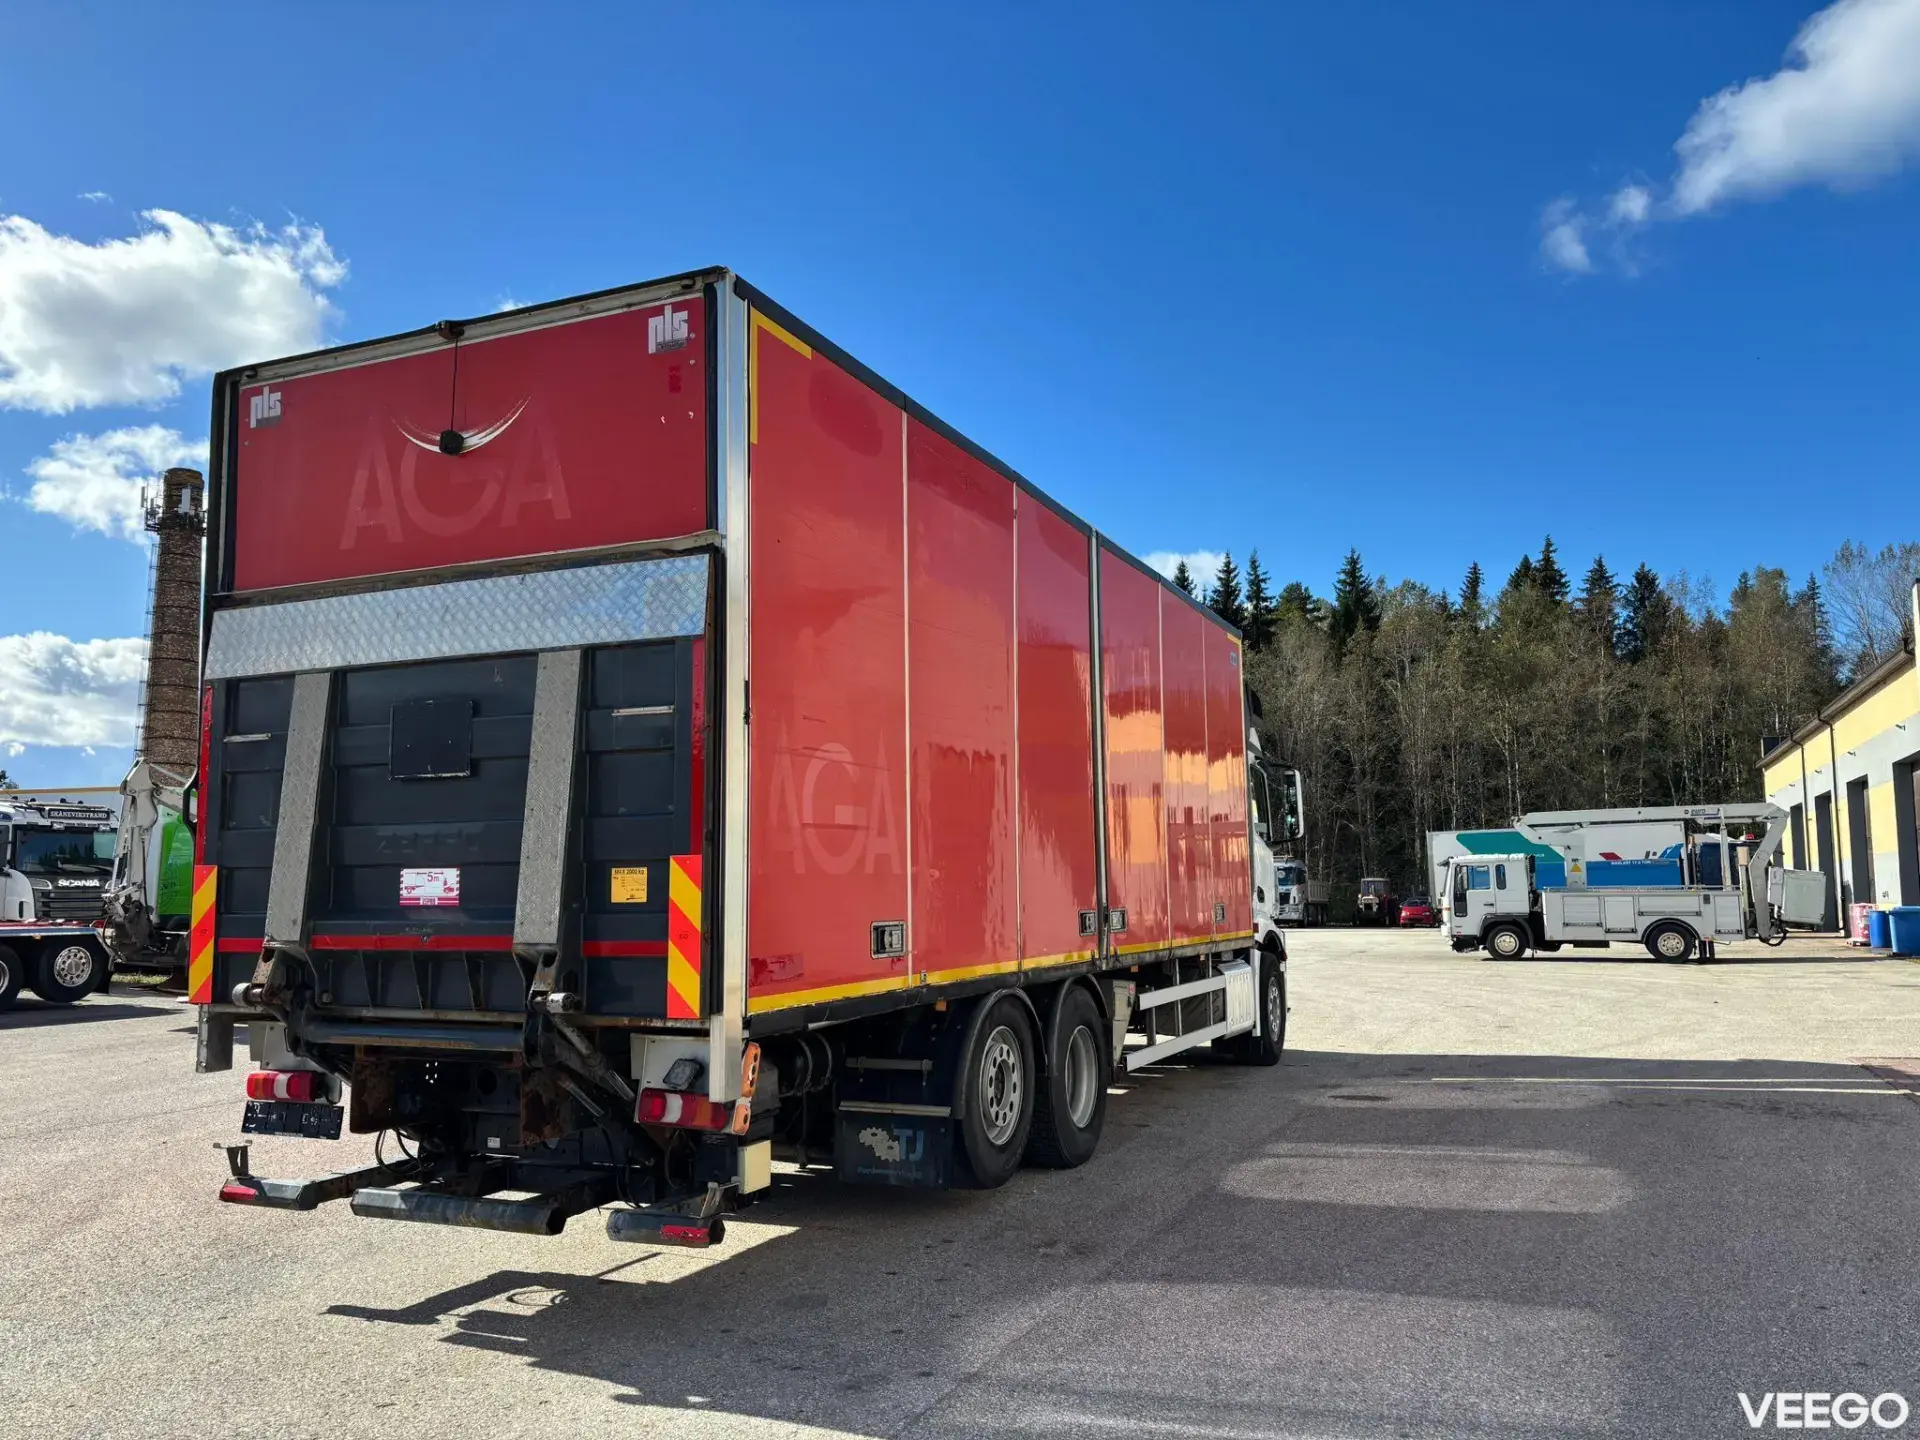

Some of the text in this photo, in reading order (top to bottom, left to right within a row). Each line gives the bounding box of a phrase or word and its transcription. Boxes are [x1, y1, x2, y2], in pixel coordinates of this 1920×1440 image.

[649, 304, 688, 354] pls
[250, 386, 281, 428] pls
[338, 390, 572, 551] AGA
[758, 715, 902, 875] AGA
[58, 879, 100, 887] SCANIA
[893, 1129, 924, 1161] TJ
